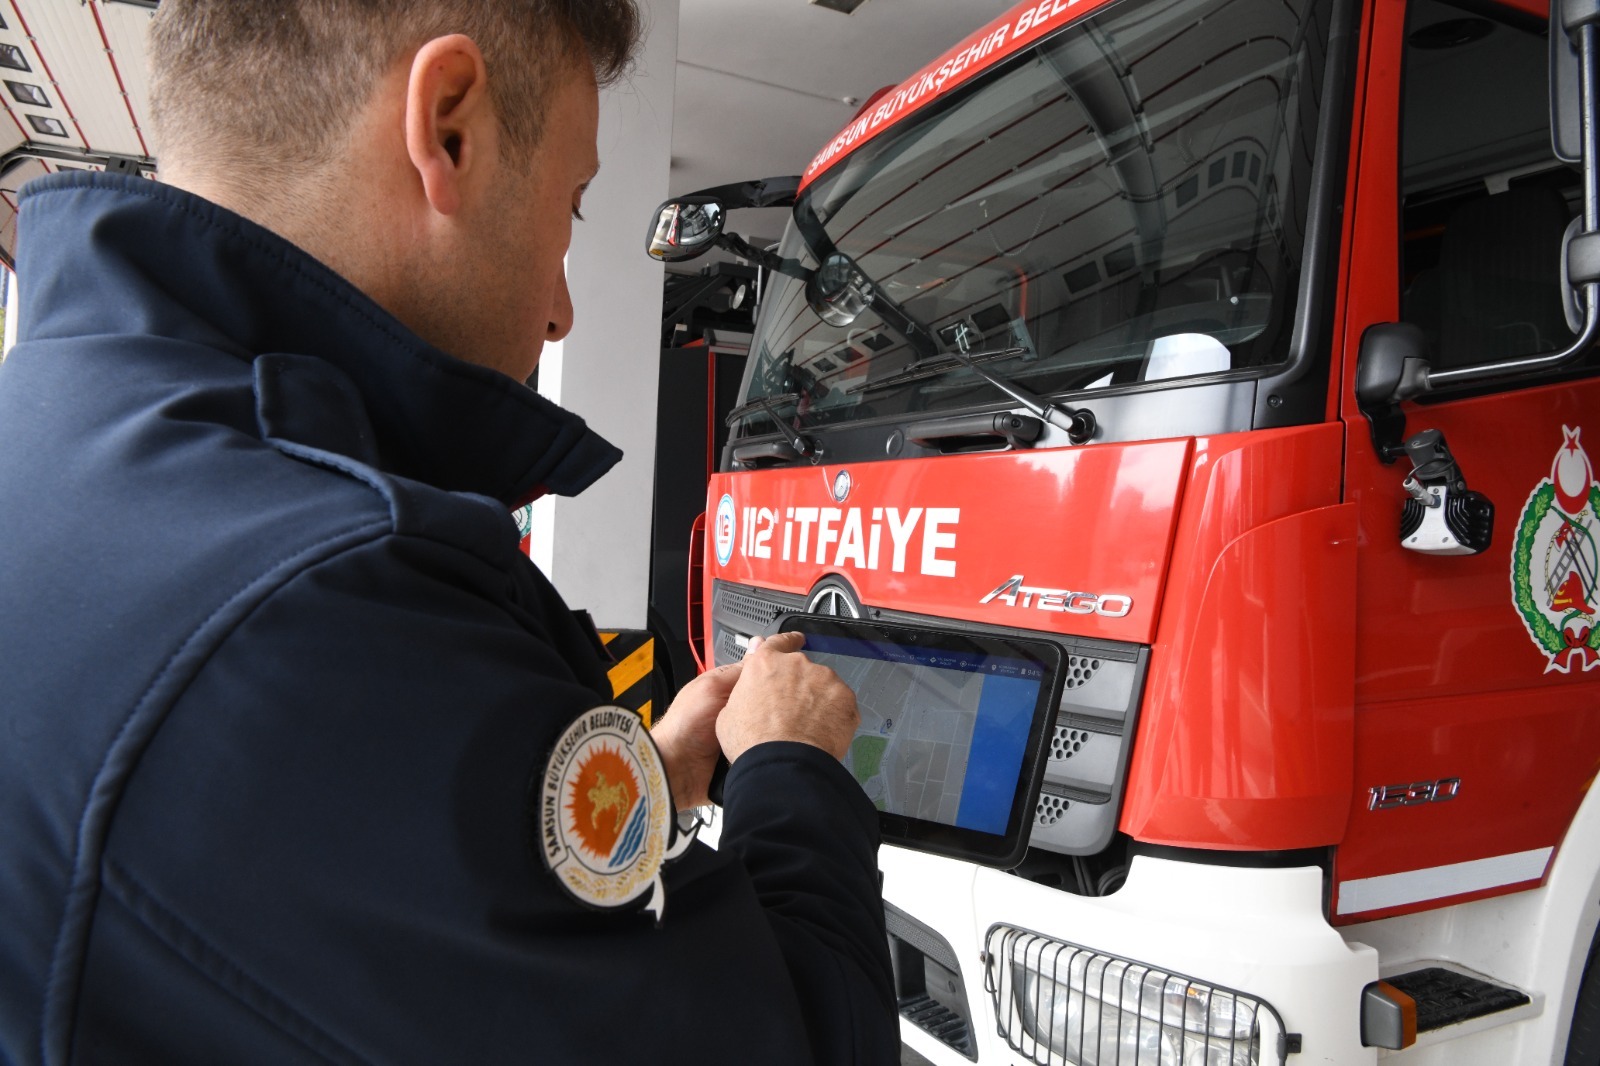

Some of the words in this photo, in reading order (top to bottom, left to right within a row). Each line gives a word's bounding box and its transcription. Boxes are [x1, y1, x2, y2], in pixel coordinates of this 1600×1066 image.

[807, 113, 874, 175] SAMSUN
[870, 22, 1011, 128] BÜYÜKŞEHİR
[1012, 0, 1081, 39] BEL
[740, 506, 774, 560] 112
[979, 574, 1133, 618] ATEGO
[544, 796, 561, 858] SAMSUN
[589, 708, 636, 735] BELEDİYESİ
